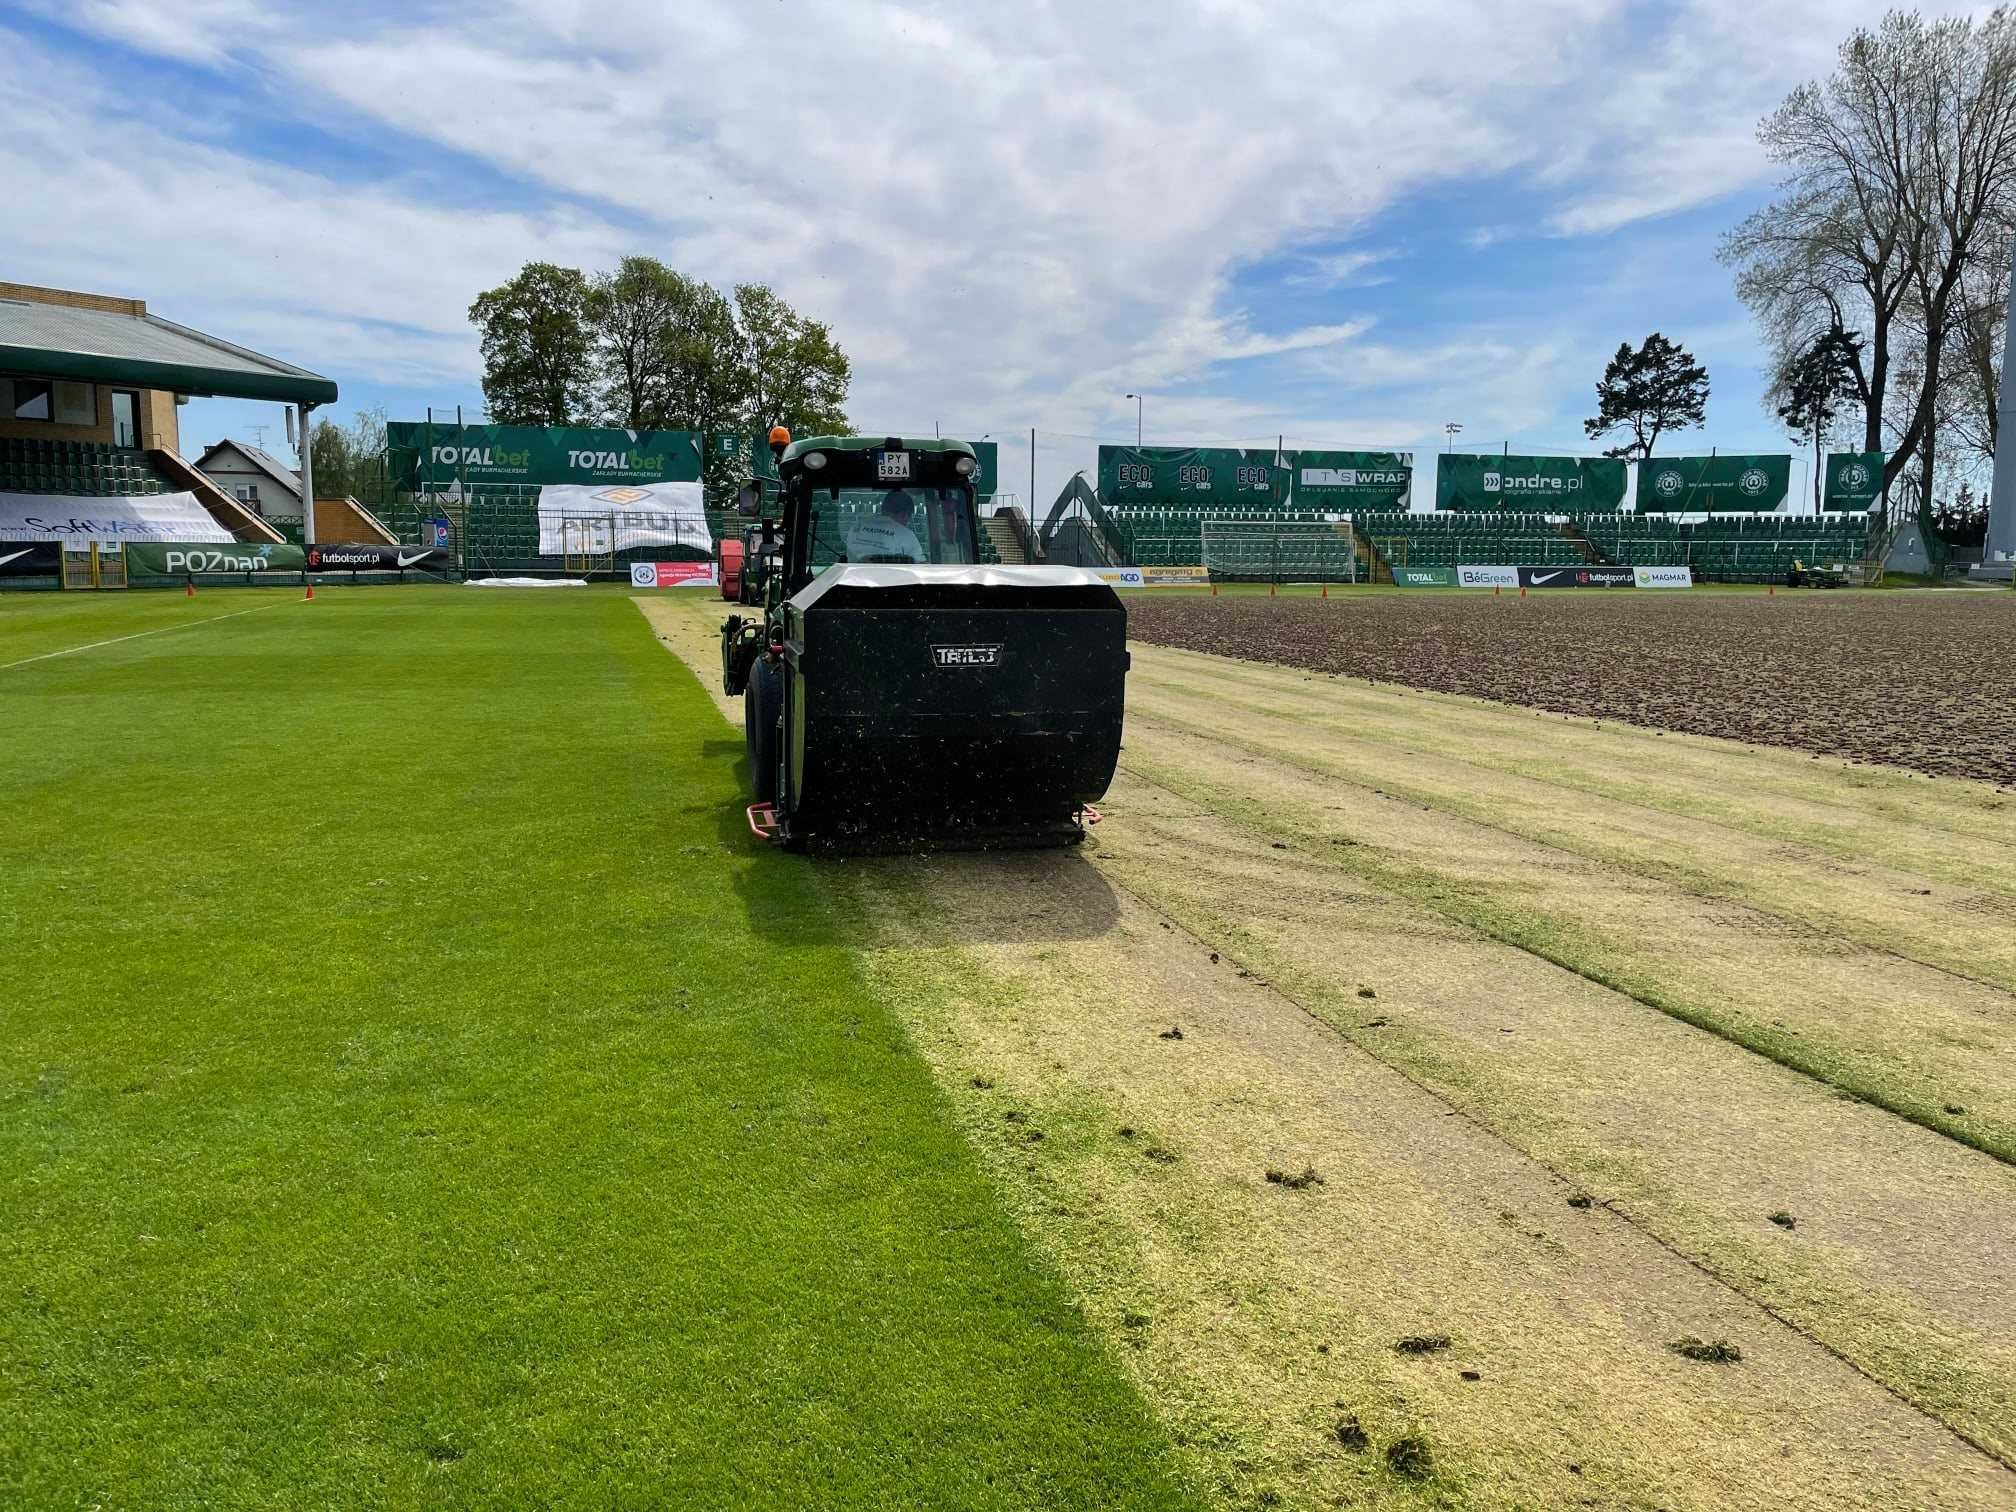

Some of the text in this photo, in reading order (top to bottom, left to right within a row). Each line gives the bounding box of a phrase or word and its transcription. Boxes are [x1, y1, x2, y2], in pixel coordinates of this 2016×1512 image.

[724, 439, 732, 450] E
[568, 450, 664, 470] TOTALbet
[888, 455, 901, 463] PY
[881, 467, 907, 475] 582A
[1119, 464, 1151, 482] ECO
[1180, 466, 1209, 483] ECO
[1237, 467, 1267, 484] ECO
[322, 553, 380, 565] futbolsport.pl
[1464, 572, 1514, 583] BéGreen
[1589, 573, 1633, 582] futbolsport.pl
